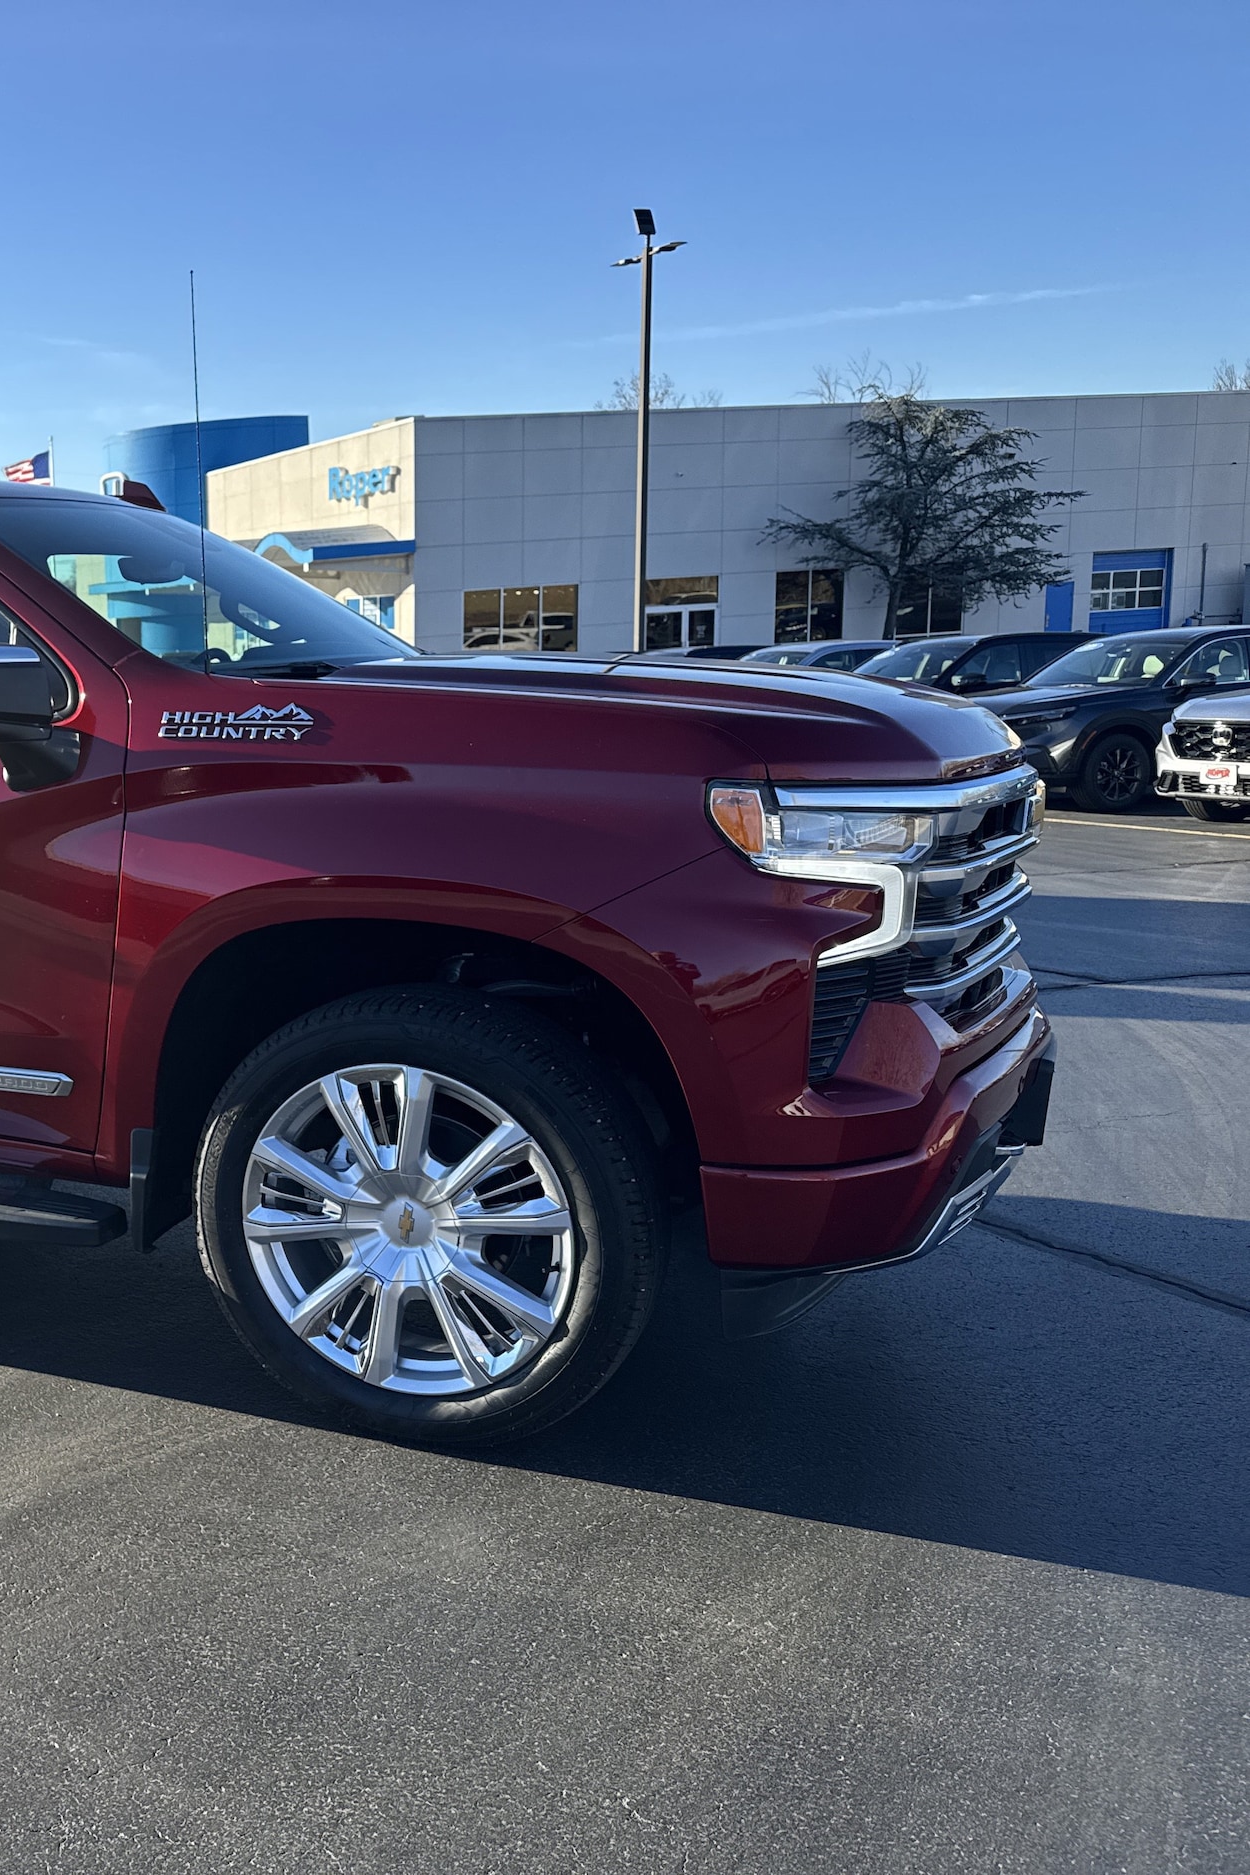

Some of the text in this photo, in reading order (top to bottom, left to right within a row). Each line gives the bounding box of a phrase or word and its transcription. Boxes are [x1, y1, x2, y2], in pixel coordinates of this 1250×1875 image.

[328, 466, 400, 508] Roper
[161, 711, 236, 724] HIGH
[158, 726, 311, 740] COUNTRY
